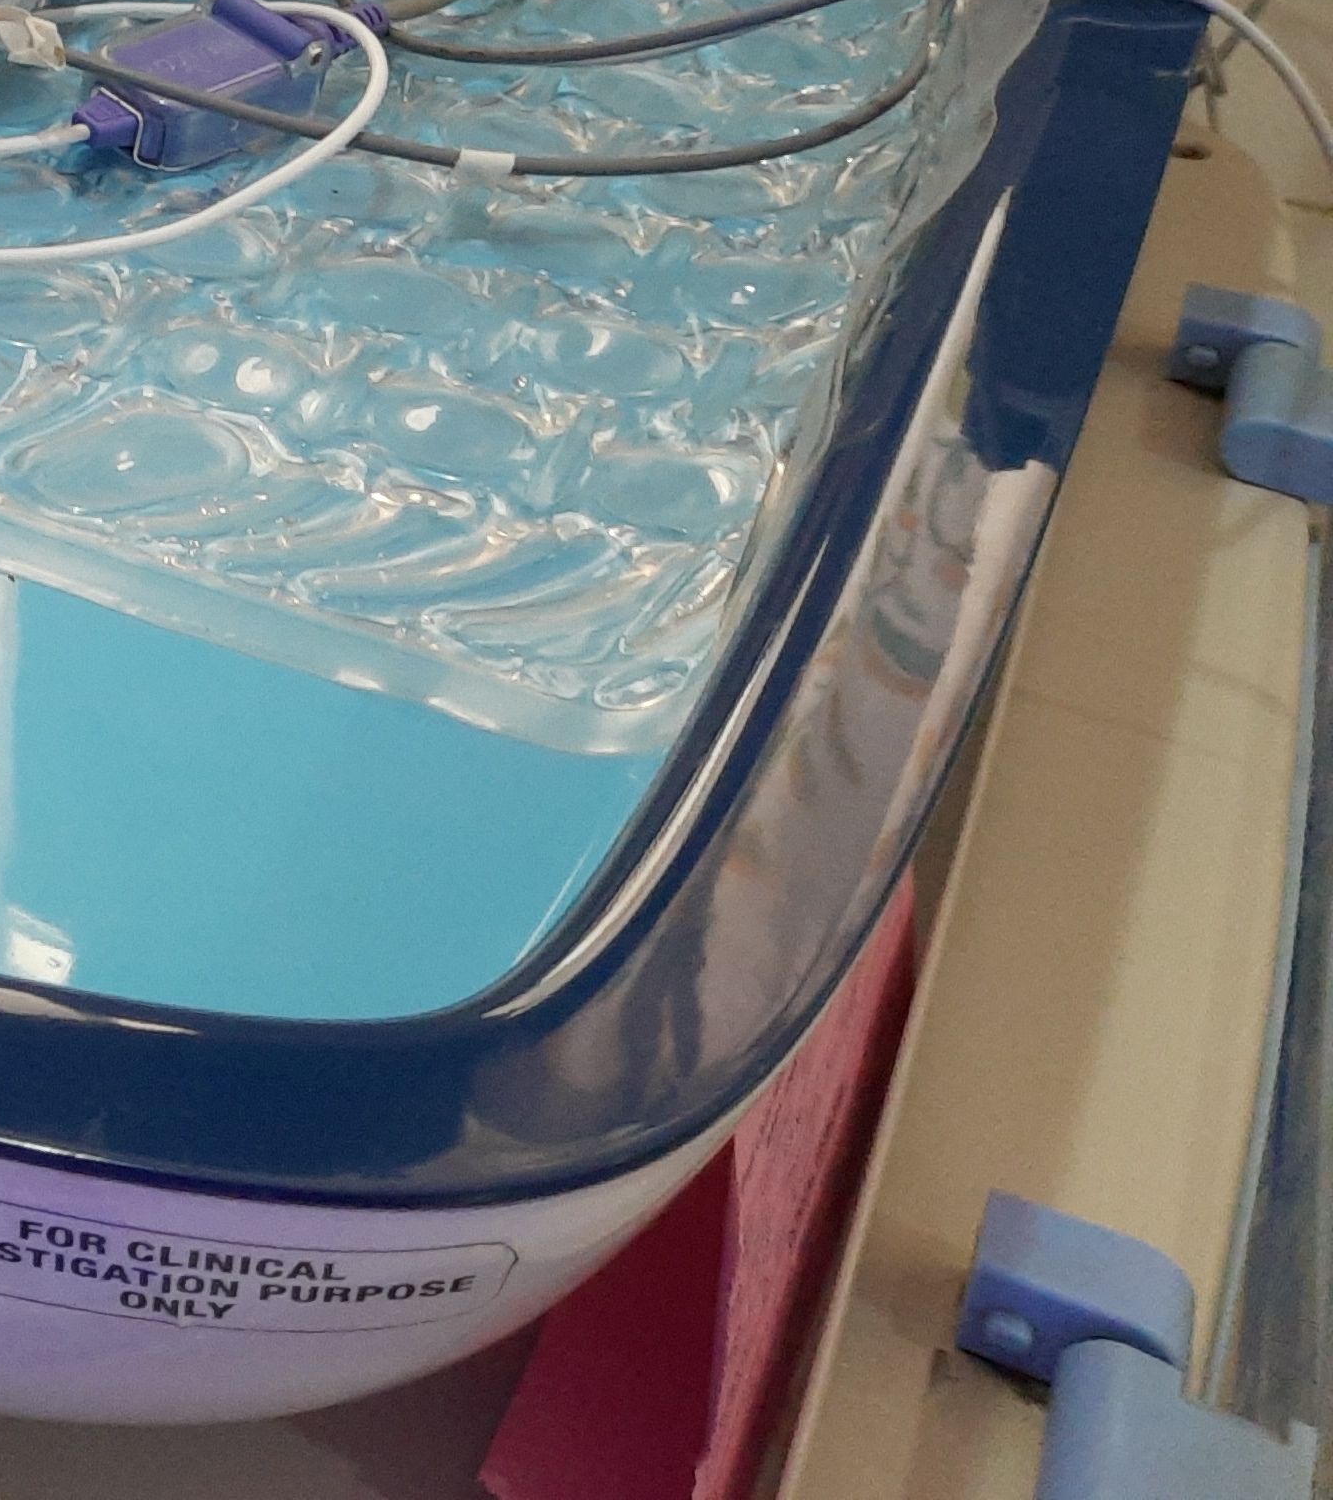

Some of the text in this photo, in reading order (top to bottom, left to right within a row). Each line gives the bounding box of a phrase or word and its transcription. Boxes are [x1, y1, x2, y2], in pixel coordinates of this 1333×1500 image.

[18, 1218, 345, 1283] FOR CLINICAL
[258, 1274, 477, 1303] PURPOSE
[118, 1289, 236, 1321] ONLY
